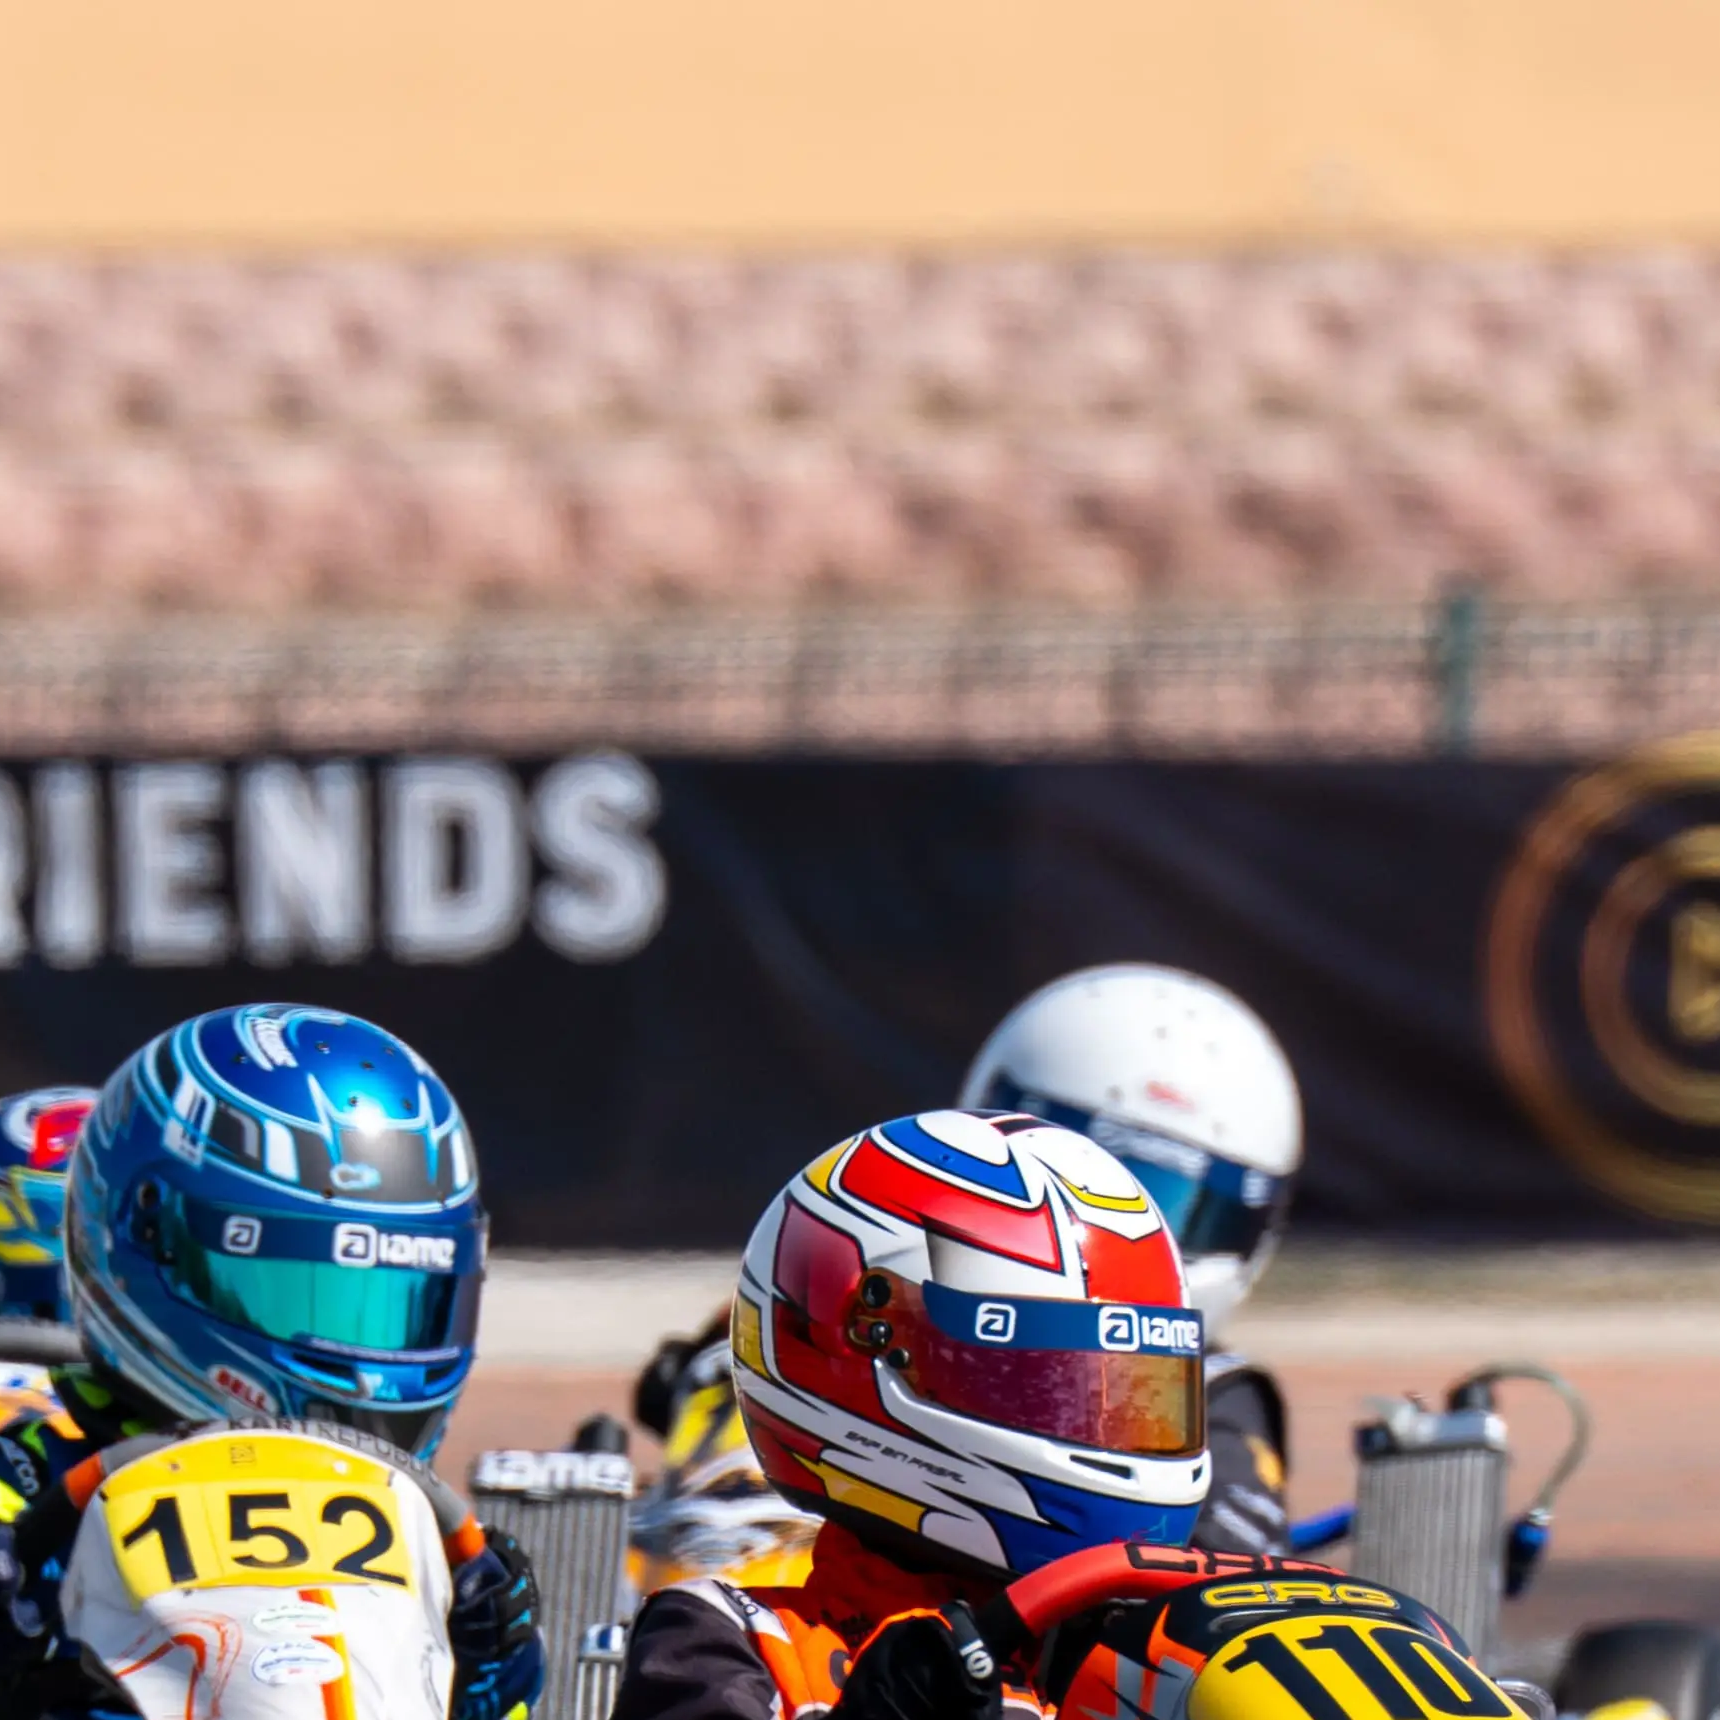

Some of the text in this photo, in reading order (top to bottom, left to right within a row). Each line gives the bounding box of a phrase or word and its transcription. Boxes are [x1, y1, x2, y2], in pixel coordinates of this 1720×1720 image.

[216, 1368, 268, 1411] BELL
[123, 1491, 406, 1587] 152
[1200, 1580, 1400, 1610] CRG
